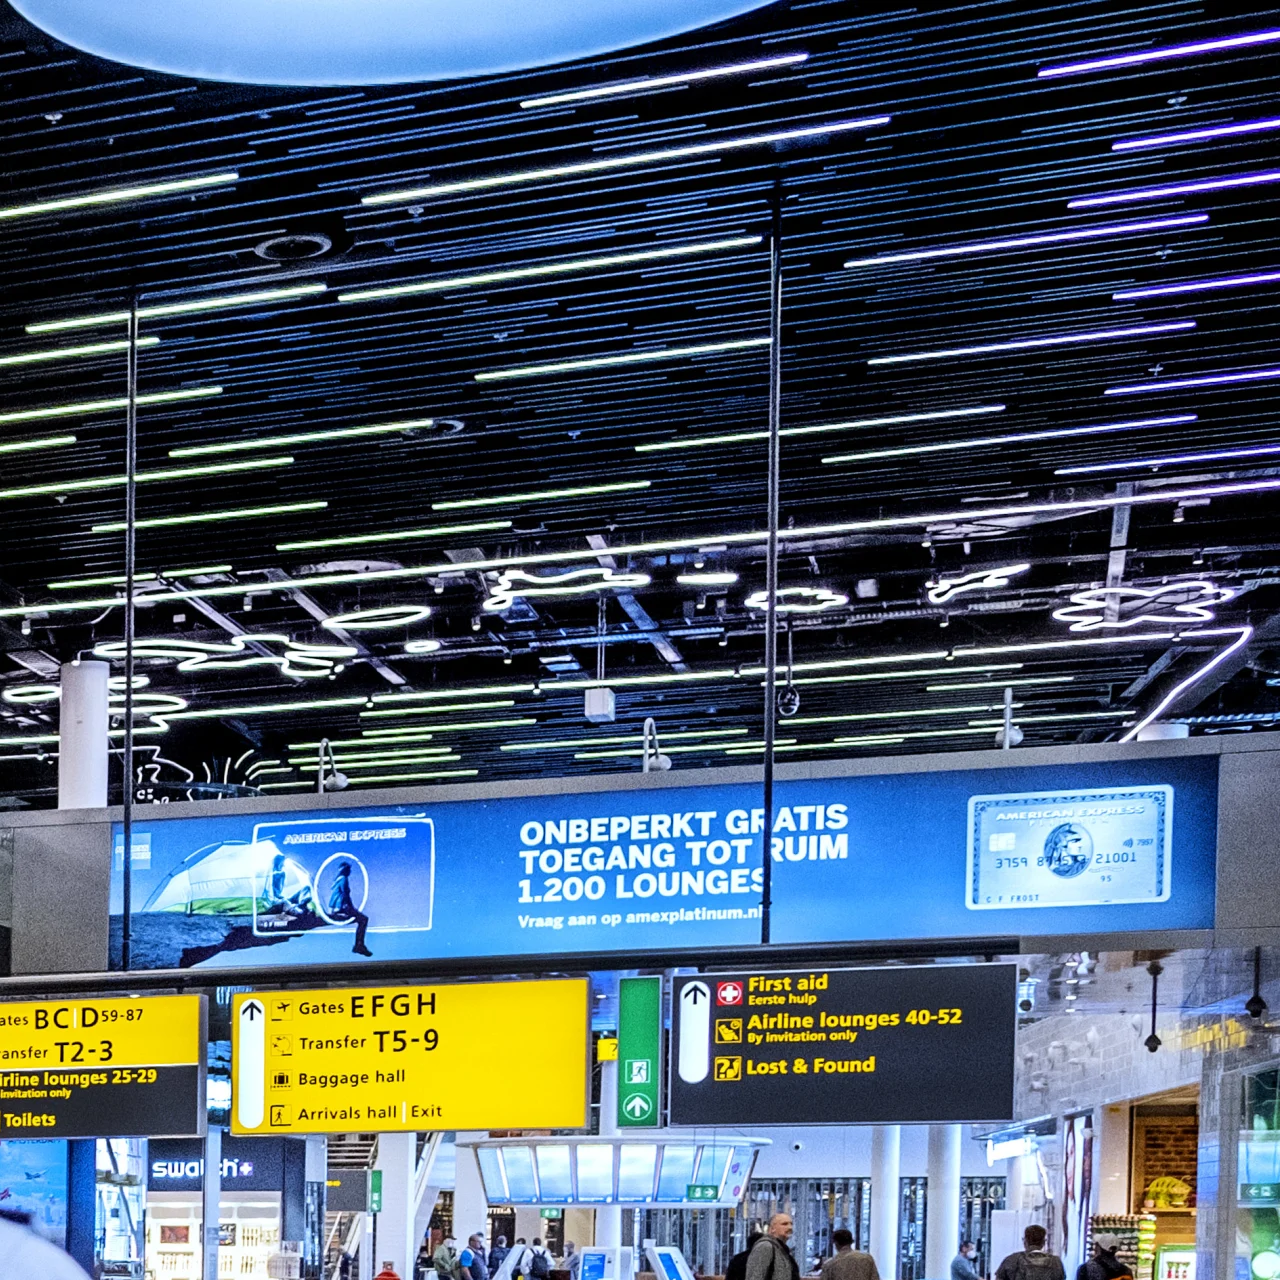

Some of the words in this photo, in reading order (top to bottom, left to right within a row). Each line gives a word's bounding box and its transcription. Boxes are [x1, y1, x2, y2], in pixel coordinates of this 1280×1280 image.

[995, 808, 1074, 821] AMERICAN
[1077, 805, 1145, 817] EXPRESS
[520, 811, 717, 846] ONBEPERKT
[725, 803, 849, 834] GRATIS
[519, 843, 675, 875] TOEGANG
[686, 838, 752, 866] TOT
[771, 833, 849, 862] RUIM
[517, 875, 606, 903] 1.200
[616, 866, 772, 898] LOUNGES
[518, 914, 563, 930] Vraag
[568, 914, 596, 926] aan
[601, 914, 621, 927] op
[625, 904, 763, 925] amexplatinum.nl
[748, 976, 792, 993] First
[797, 973, 829, 991] aid
[299, 1000, 345, 1016] Gates
[748, 994, 786, 1006] Eerste
[788, 993, 817, 1005] hulp
[747, 1013, 814, 1031] Airline
[819, 1010, 900, 1031] lounges
[904, 1008, 963, 1026] 40-52
[299, 1036, 368, 1051] Transfer
[374, 1028, 440, 1053] T5-9
[747, 1033, 762, 1045] By
[765, 1030, 826, 1043] invitation
[829, 1030, 858, 1043] only
[54, 1040, 114, 1063] T2-3
[746, 1060, 788, 1075] Lost
[792, 1058, 808, 1074] &
[813, 1056, 876, 1074] Found
[44, 1070, 108, 1090] lounges
[112, 1069, 158, 1084] 25-29
[298, 1072, 369, 1089] Baggage
[376, 1069, 406, 1084] hall
[0, 1088, 47, 1099] invitation
[49, 1088, 72, 1100] only
[3, 1113, 57, 1128] Toilets
[297, 1105, 361, 1121] Arrivals
[368, 1104, 397, 1119] hall
[411, 1104, 443, 1118] Exit
[152, 1158, 240, 1178] swah
